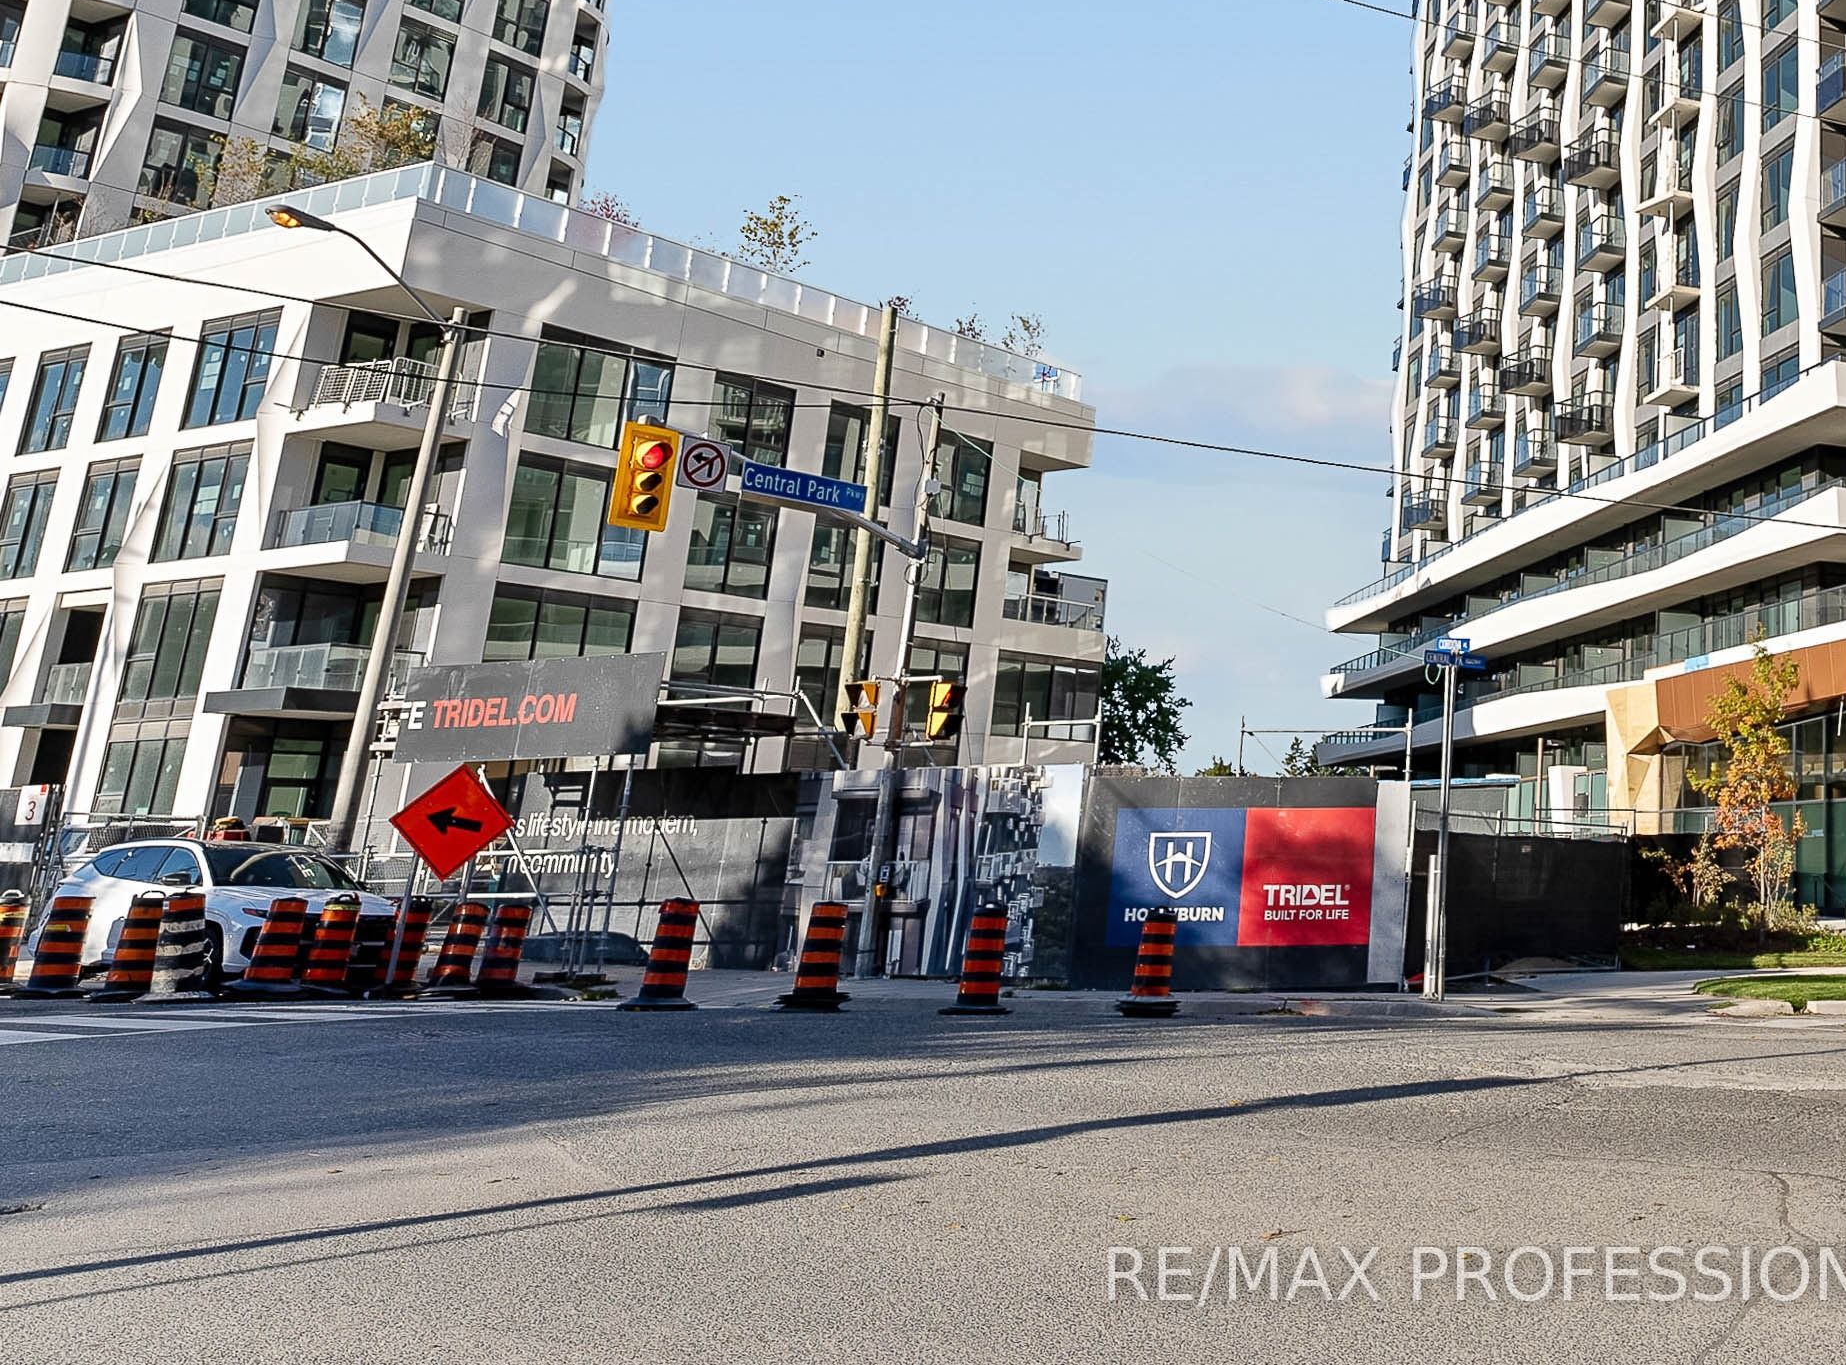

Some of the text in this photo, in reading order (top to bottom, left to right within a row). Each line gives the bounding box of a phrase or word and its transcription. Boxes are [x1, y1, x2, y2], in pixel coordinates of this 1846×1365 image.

[744, 467, 801, 495] Central
[807, 480, 841, 503] Park
[432, 692, 577, 729] TRIDEL.COM
[25, 800, 37, 821] 3
[519, 851, 620, 879] communty.
[1263, 884, 1349, 906] TRIDEL
[1124, 907, 1225, 922] HOBURN
[1264, 909, 1349, 921] BUILT FOR LIFE
